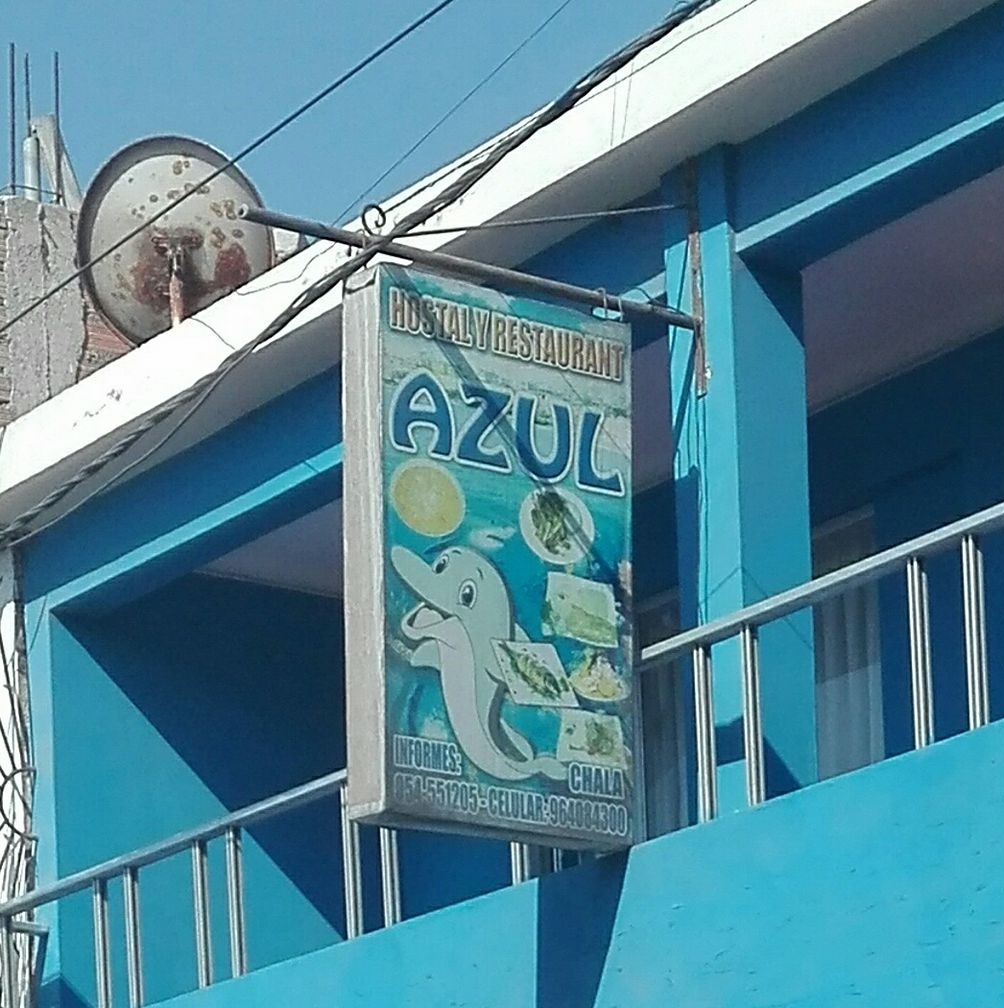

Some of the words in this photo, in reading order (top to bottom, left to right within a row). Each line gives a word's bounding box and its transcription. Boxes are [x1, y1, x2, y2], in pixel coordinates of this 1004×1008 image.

[390, 288, 472, 346] HOSTAL
[473, 309, 490, 350] Y
[492, 314, 624, 380] RESTAURANT
[390, 369, 625, 496] AZUL
[394, 735, 462, 775] INFORMES:
[568, 763, 625, 799] CHALA
